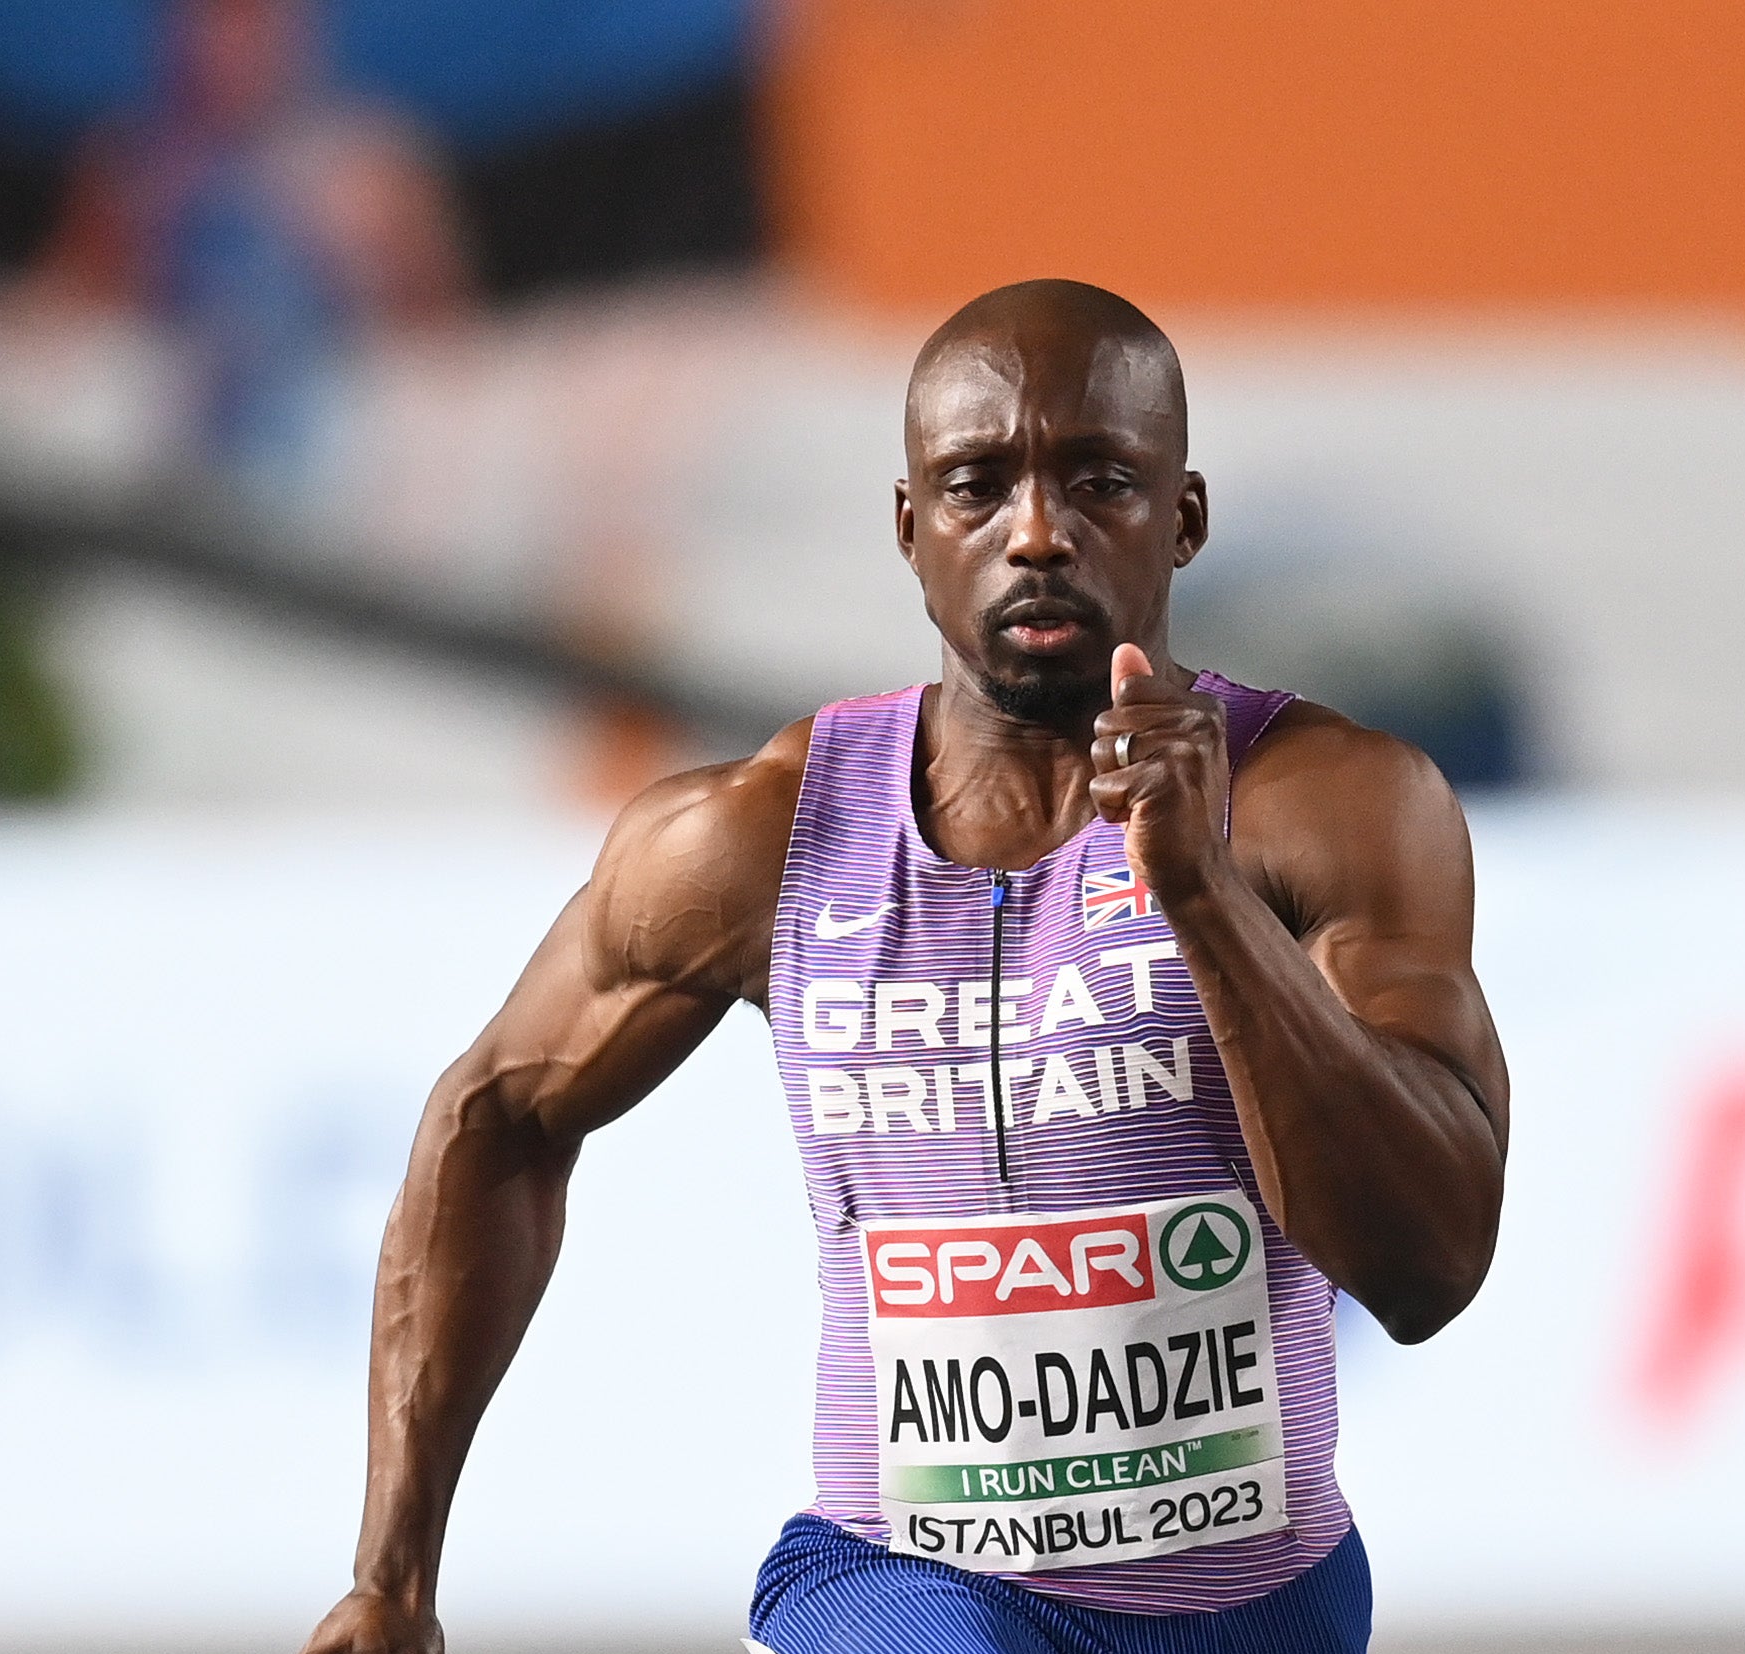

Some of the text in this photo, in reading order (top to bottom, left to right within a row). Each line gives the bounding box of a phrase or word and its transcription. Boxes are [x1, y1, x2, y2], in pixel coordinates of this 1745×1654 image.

[802, 940, 1179, 1052] GREAT
[804, 1036, 1195, 1136] BRITAIN
[875, 1228, 1145, 1305] SPAR
[889, 1320, 1265, 1444] AMO-DADZIE
[908, 1481, 1264, 1556] ISTANBUL 2023
[961, 1468, 971, 1497] I
[981, 1462, 1055, 1497] RUN
